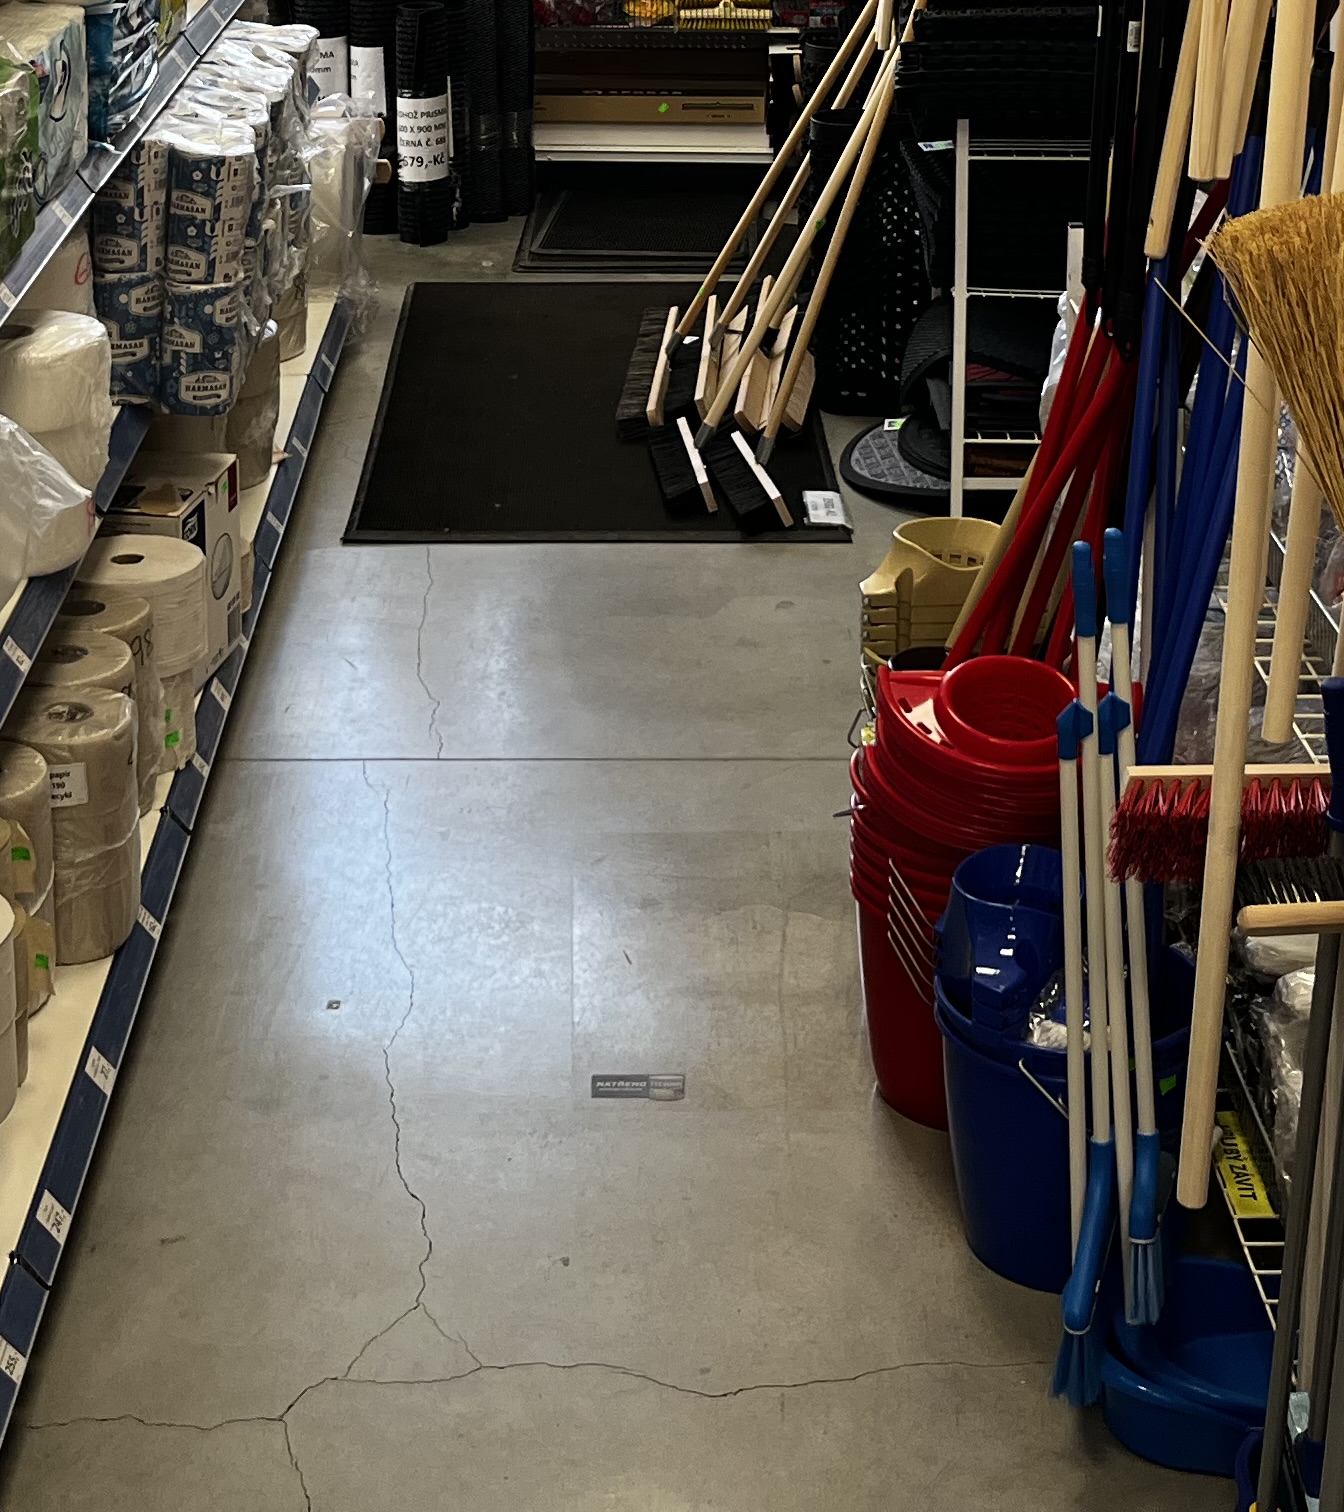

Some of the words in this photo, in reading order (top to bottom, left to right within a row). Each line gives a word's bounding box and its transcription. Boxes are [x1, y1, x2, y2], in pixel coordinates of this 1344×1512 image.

[417, 124, 433, 134] 900
[184, 382, 228, 393] HARMASAN
[1228, 1163, 1258, 1201] ZÁVIT
